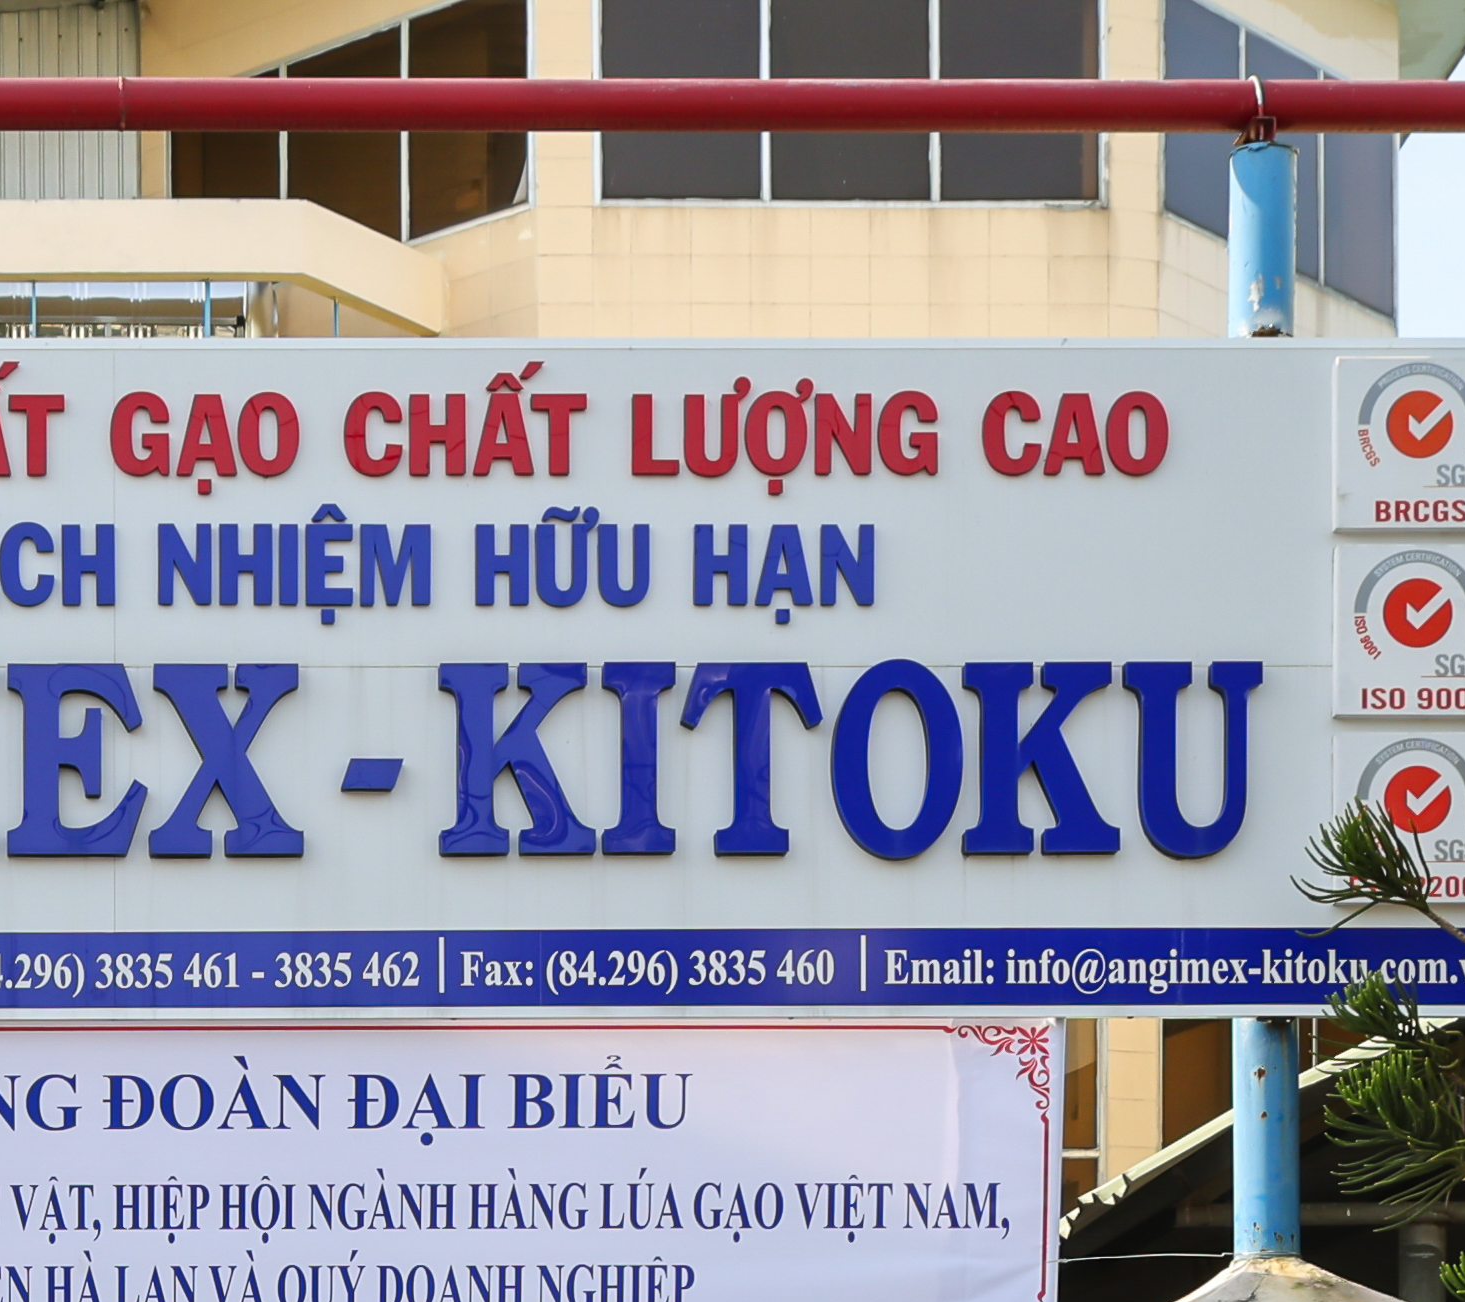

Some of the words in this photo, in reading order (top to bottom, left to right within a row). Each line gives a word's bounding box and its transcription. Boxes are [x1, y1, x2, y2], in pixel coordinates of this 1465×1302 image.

[110, 391, 300, 496] GẠO
[344, 361, 588, 477] CHẤT
[631, 376, 939, 496] LƯỢNG
[982, 390, 1170, 477] CAO
[1358, 429, 1381, 468] BRCGS
[157, 503, 433, 625] NHIỆM
[474, 505, 652, 608] HỮU
[692, 523, 876, 624] HẠN
[1373, 555, 1405, 578] SYSTEM
[1404, 552, 1462, 578] CERTIFICATION
[1354, 615, 1367, 635] ISO
[1360, 635, 1382, 660] 9001
[1361, 687, 1406, 710] ISO
[437, 656, 1266, 860] KITOKU
[1404, 740, 1461, 765] CERTIFICATION
[94, 952, 173, 990] 3835
[183, 952, 240, 990] 461
[274, 951, 352, 989] 3835
[362, 951, 420, 989] 462
[460, 951, 534, 988] Fax:
[546, 949, 679, 997] (84.296)
[688, 949, 767, 987] 3835
[776, 949, 835, 987] 460
[884, 948, 995, 986] Email:
[109, 1056, 324, 1132] ĐOÀN
[347, 1072, 486, 1147] ĐẠI
[508, 1053, 693, 1131] BIỂU
[12, 1175, 104, 1245] VẬT,
[116, 1183, 211, 1244] HIỆP
[222, 1175, 294, 1245] HỘI
[308, 1167, 456, 1231] NGÀNH
[470, 1167, 590, 1231] HÀNG
[602, 1168, 684, 1231] LÚA
[694, 1181, 784, 1243] GẠO
[798, 1174, 891, 1244] VIỆT
[904, 1180, 1011, 1240] NAM,
